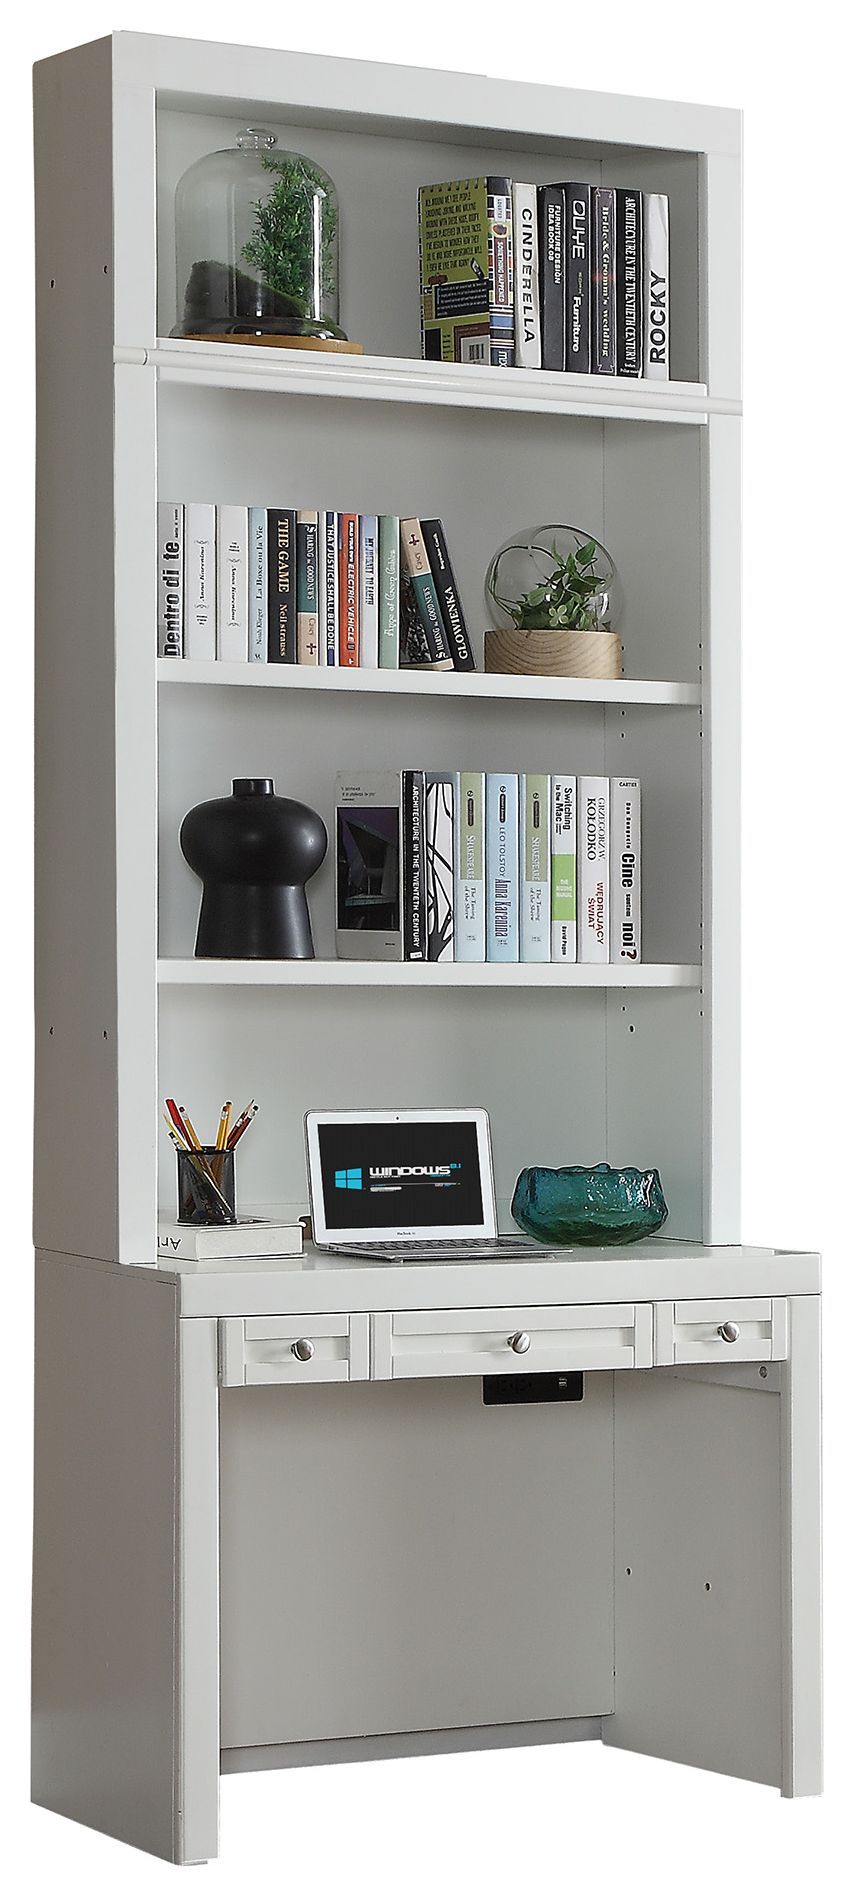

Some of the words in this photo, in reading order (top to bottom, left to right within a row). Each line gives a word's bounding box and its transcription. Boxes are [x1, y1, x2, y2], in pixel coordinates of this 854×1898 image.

[602, 206, 610, 239] Bride
[602, 240, 610, 251] &
[522, 208, 536, 343] CINDERELLA
[625, 265, 636, 282] THE
[602, 309, 610, 357] wedding
[650, 270, 666, 364] ROCKY
[625, 327, 636, 362] CENTURY
[278, 518, 289, 548] THE
[163, 542, 180, 560] te
[327, 548, 335, 583] JUSTICE
[163, 570, 180, 588] di
[255, 565, 263, 584] Boxe
[277, 551, 289, 592] GAME
[280, 604, 288, 624] Neil
[327, 583, 335, 612] SHALL
[163, 593, 180, 657] Dentro
[327, 612, 335, 625] BE
[327, 625, 335, 650] DONE
[412, 785, 420, 841] ARCHITECTURE
[563, 787, 573, 830] Switching
[598, 797, 606, 848] GRZEGORZ
[587, 798, 597, 861] KOŁODKO
[412, 843, 420, 852] IN
[412, 855, 420, 869] THE
[621, 853, 635, 888] Cine
[495, 878, 511, 898] Anna
[412, 912, 420, 947] CENTURY
[495, 901, 511, 937] Karenina
[588, 897, 596, 930] ŚWIAT
[595, 882, 604, 945] WĘDRUJĄCY
[621, 922, 637, 960] noi?
[370, 1165, 451, 1176] WINDOWS
